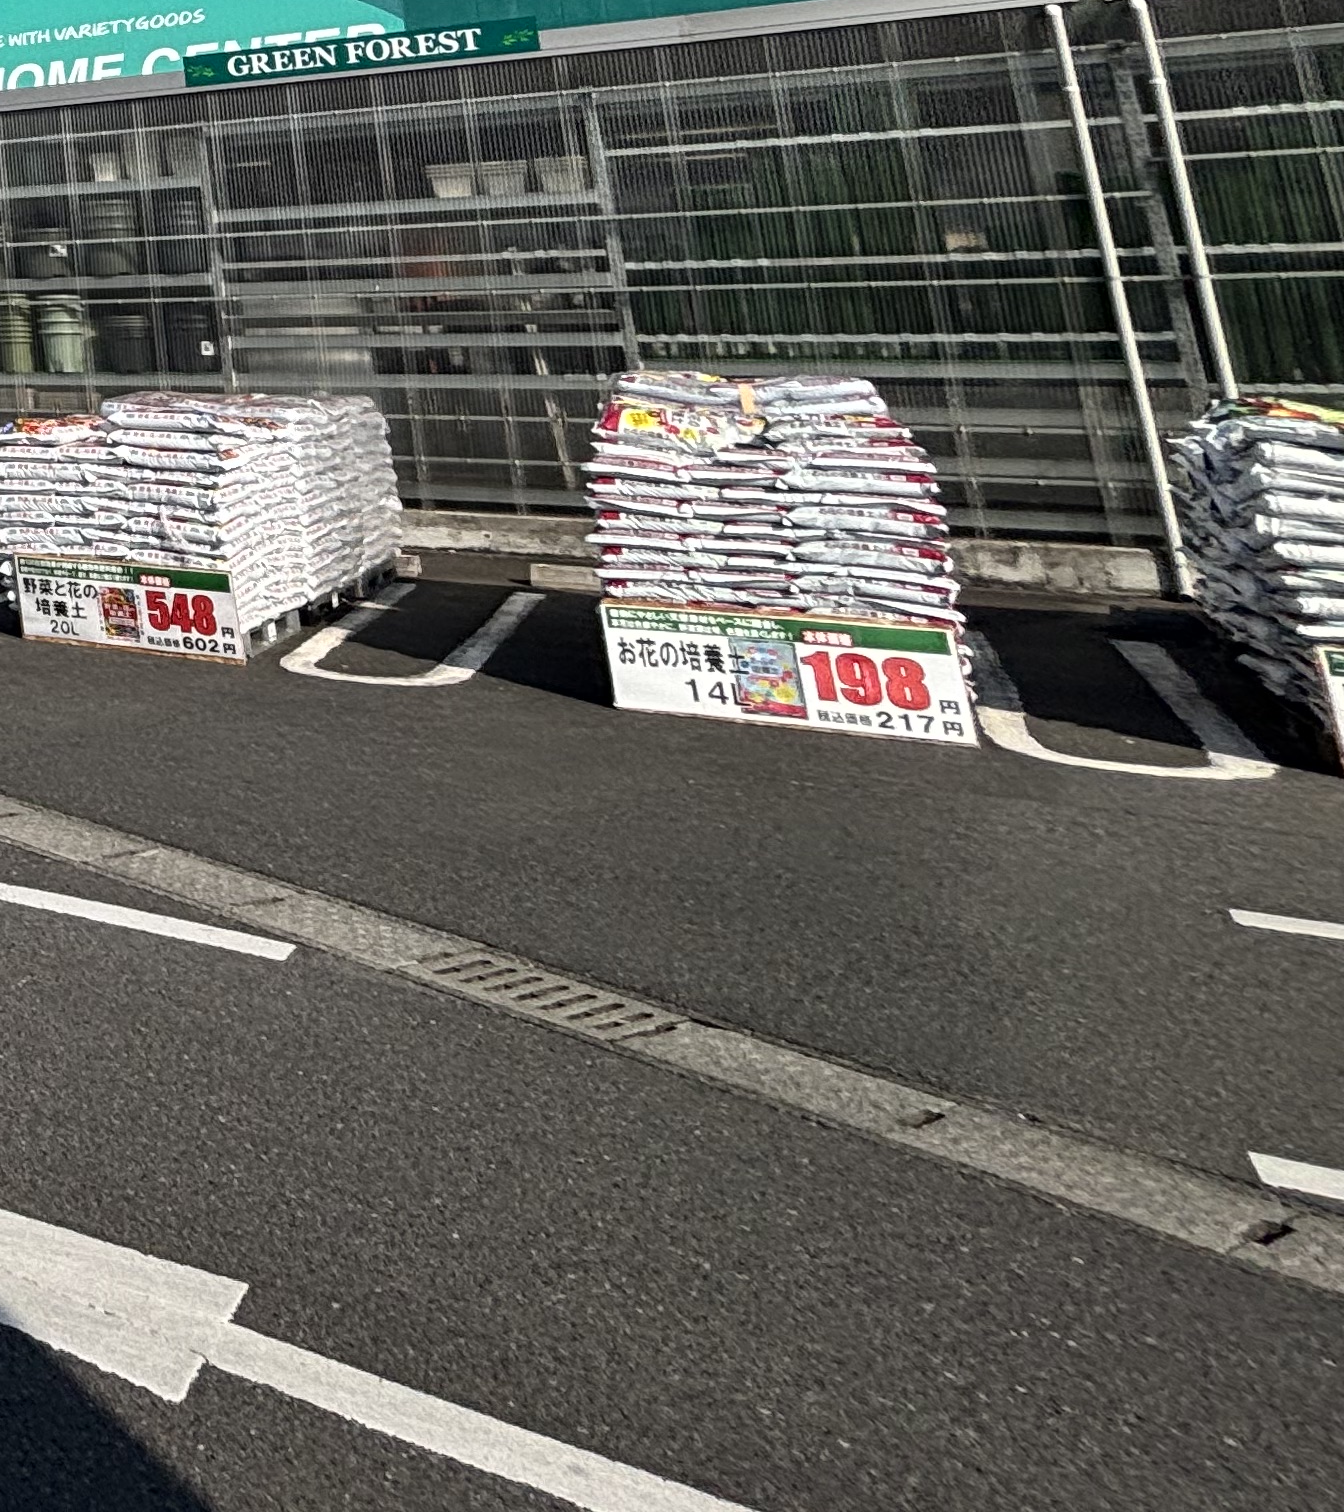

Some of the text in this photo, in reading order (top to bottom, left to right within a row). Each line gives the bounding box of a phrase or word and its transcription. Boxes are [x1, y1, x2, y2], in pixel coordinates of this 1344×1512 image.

[8, 29, 51, 47] WITH
[227, 44, 338, 77] GREEN
[346, 28, 482, 66] FOREST
[23, 577, 98, 599] 野菜と花の
[35, 597, 87, 619] 培養土
[145, 590, 217, 636] 548
[50, 619, 79, 636] 20L
[617, 637, 750, 674] お花の培養土
[800, 651, 931, 711] 198
[939, 700, 961, 715] 円
